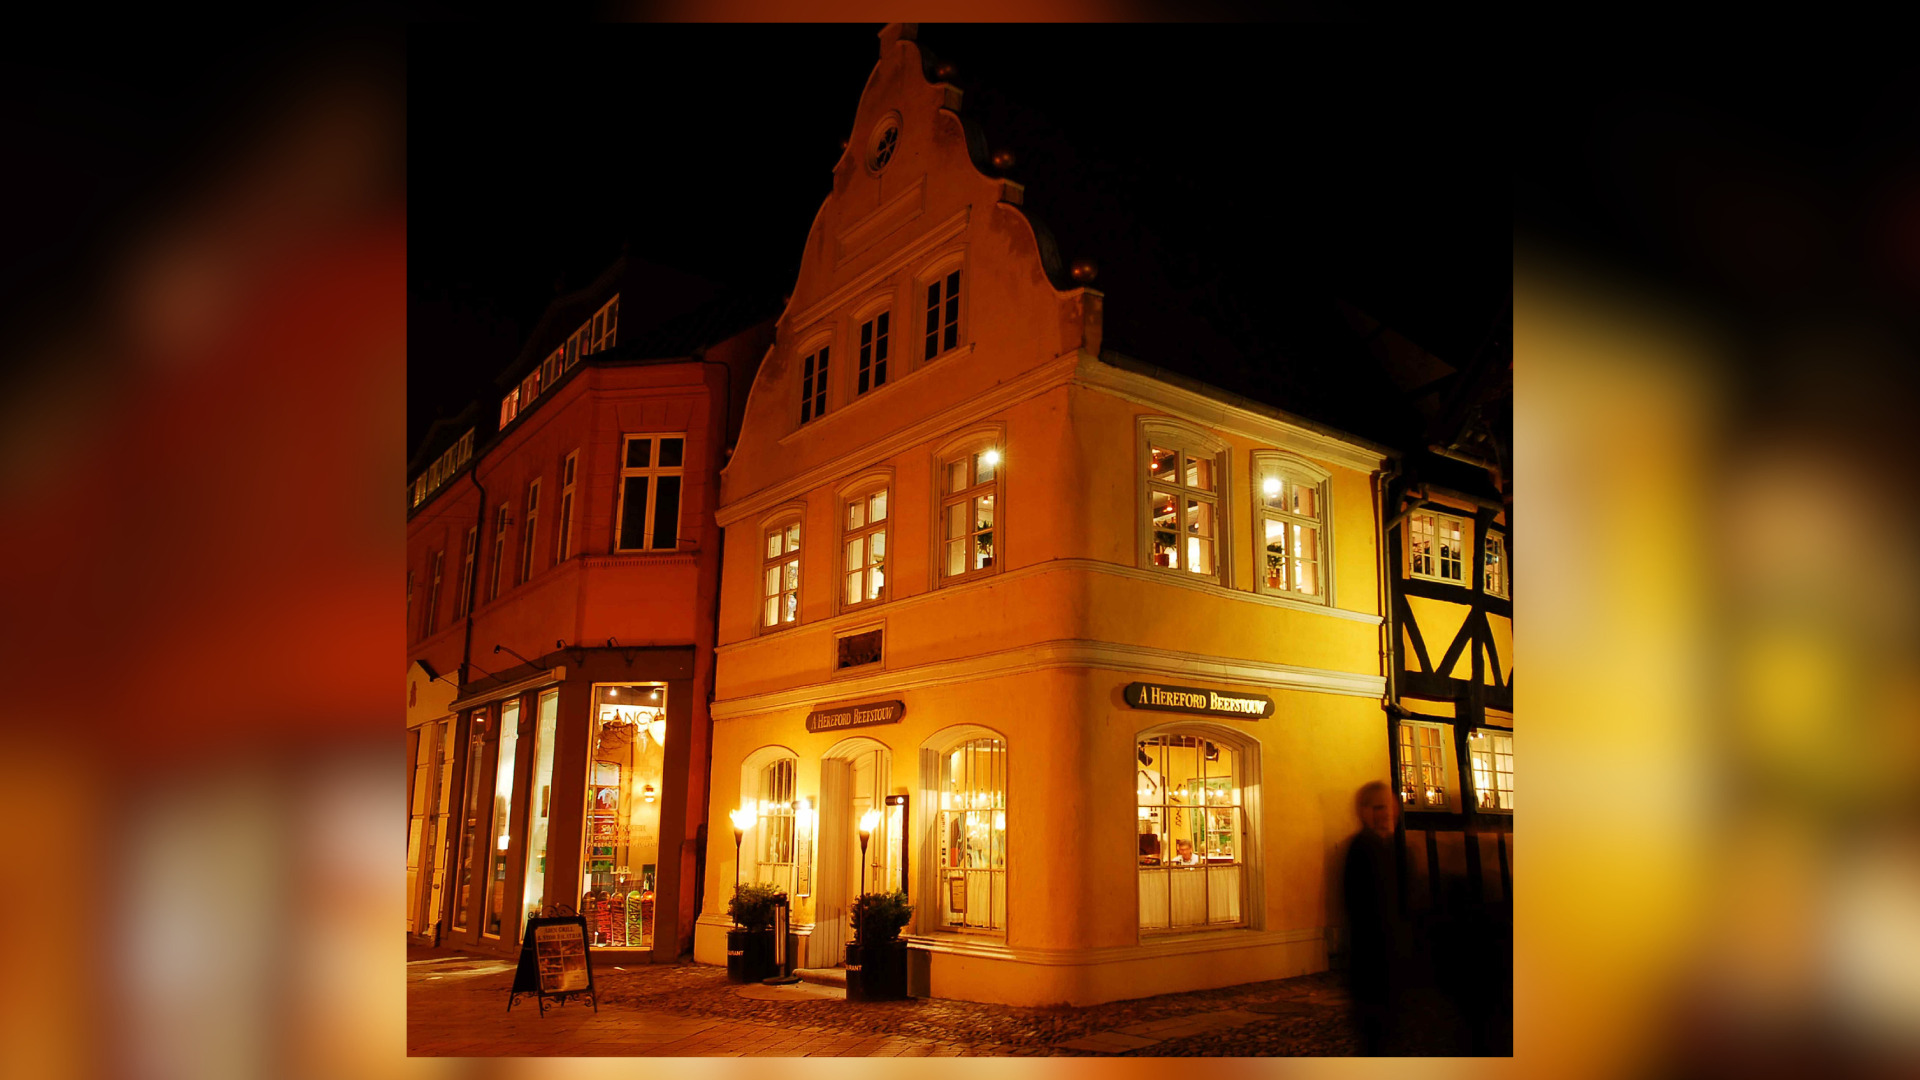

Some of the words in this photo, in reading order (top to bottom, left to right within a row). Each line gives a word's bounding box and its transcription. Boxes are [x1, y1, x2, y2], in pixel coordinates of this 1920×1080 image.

[1138, 685, 1148, 704] A
[1150, 686, 1207, 709] HEREFORD
[1209, 691, 1267, 714] BEEFSTOUW
[600, 711, 659, 726] FANCY
[810, 714, 816, 730] A
[817, 713, 851, 729] HEREFORD
[853, 706, 894, 724] BEEFSTOUW
